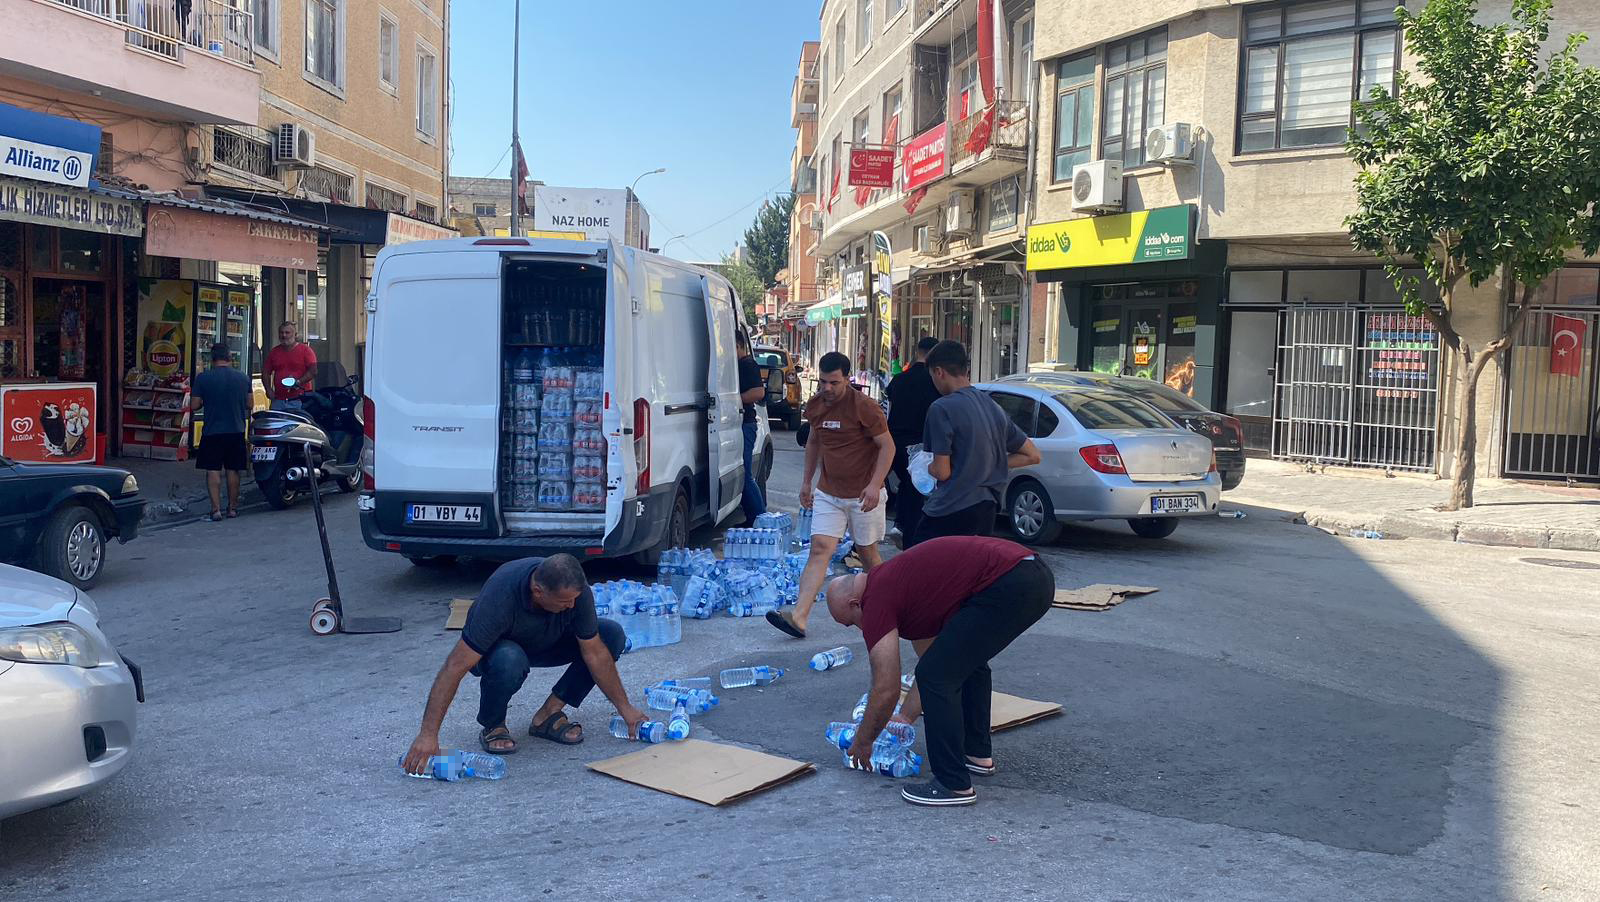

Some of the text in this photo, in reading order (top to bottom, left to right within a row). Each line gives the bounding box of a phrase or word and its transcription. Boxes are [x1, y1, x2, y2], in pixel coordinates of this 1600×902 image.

[5, 146, 60, 173] Allianz
[868, 155, 893, 163] SAADET
[24, 185, 92, 224] HİZMETLERİ
[552, 215, 610, 227] NAZ HOME
[1030, 236, 1055, 253] iddaa
[1144, 236, 1162, 246] iddaa
[152, 353, 176, 363] Lipton
[11, 434, 34, 442] ALGIDA
[1158, 497, 1197, 509] 01 BAN 334
[413, 506, 479, 520] 01 VBY 44
